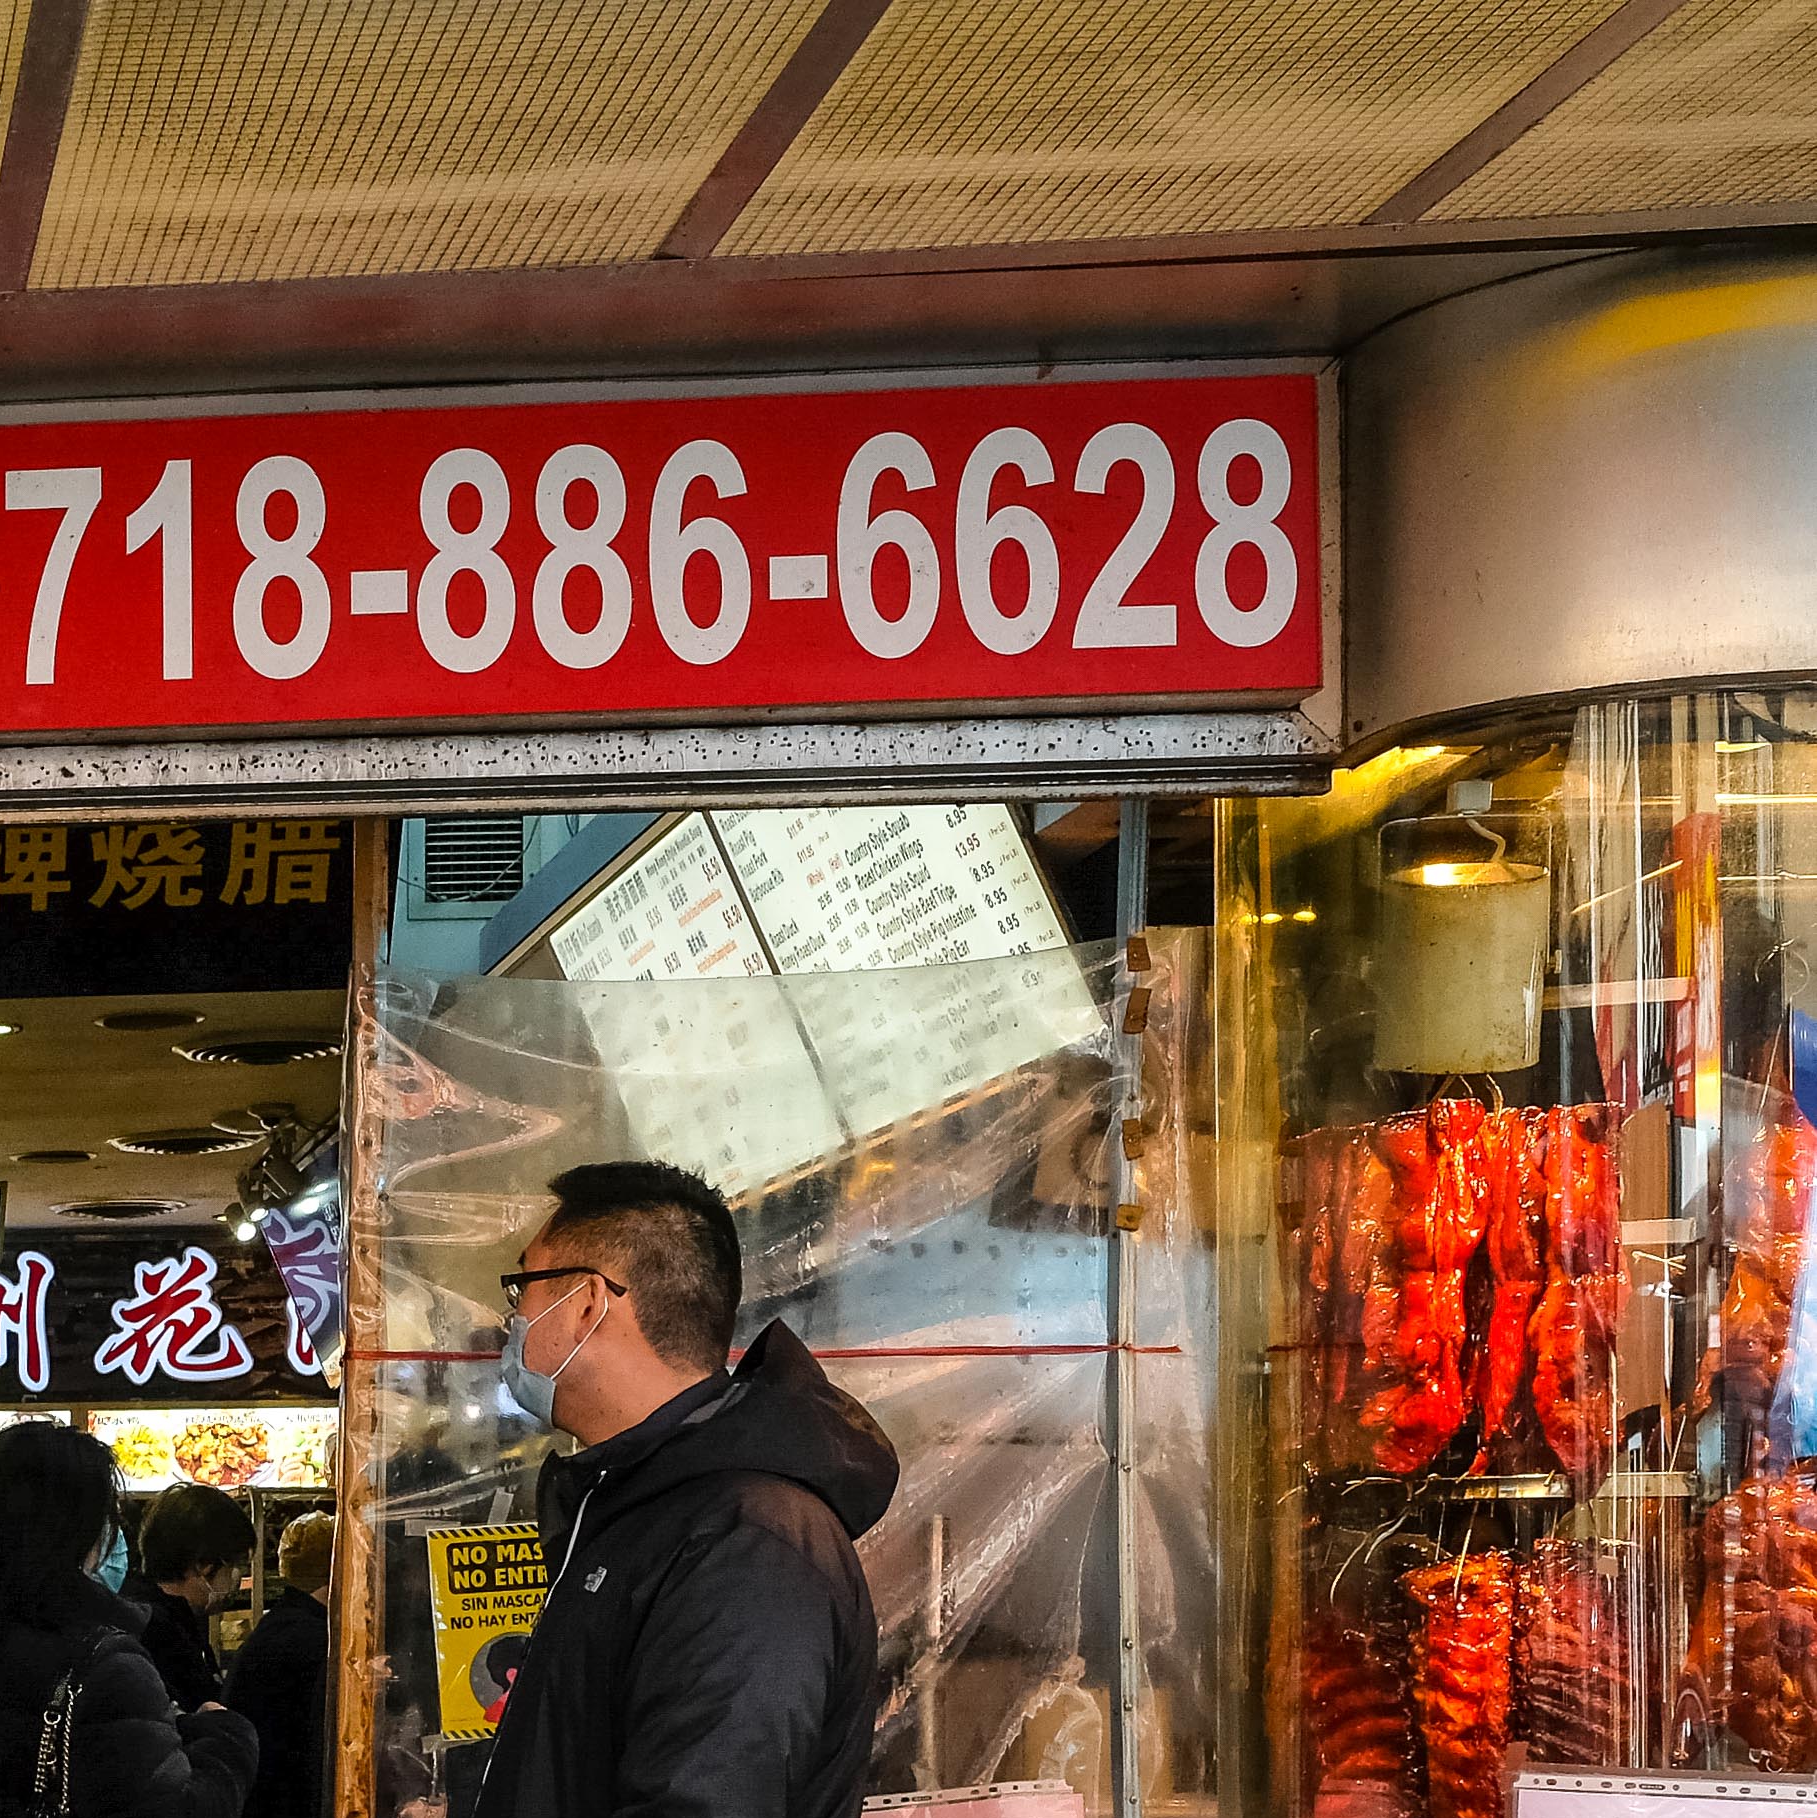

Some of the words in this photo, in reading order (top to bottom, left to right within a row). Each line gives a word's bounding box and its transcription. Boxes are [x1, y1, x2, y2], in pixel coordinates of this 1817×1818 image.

[4, 417, 1294, 688] 718-886-6628
[845, 839, 872, 866] Country
[869, 827, 889, 852] Style
[874, 854, 900, 879] Chicken
[899, 838, 923, 861] Wings
[452, 1546, 488, 1566] NO
[454, 1569, 487, 1589] NO
[462, 1597, 488, 1611] SIN
[451, 1616, 473, 1630] NO
[479, 1614, 506, 1627] HAY
